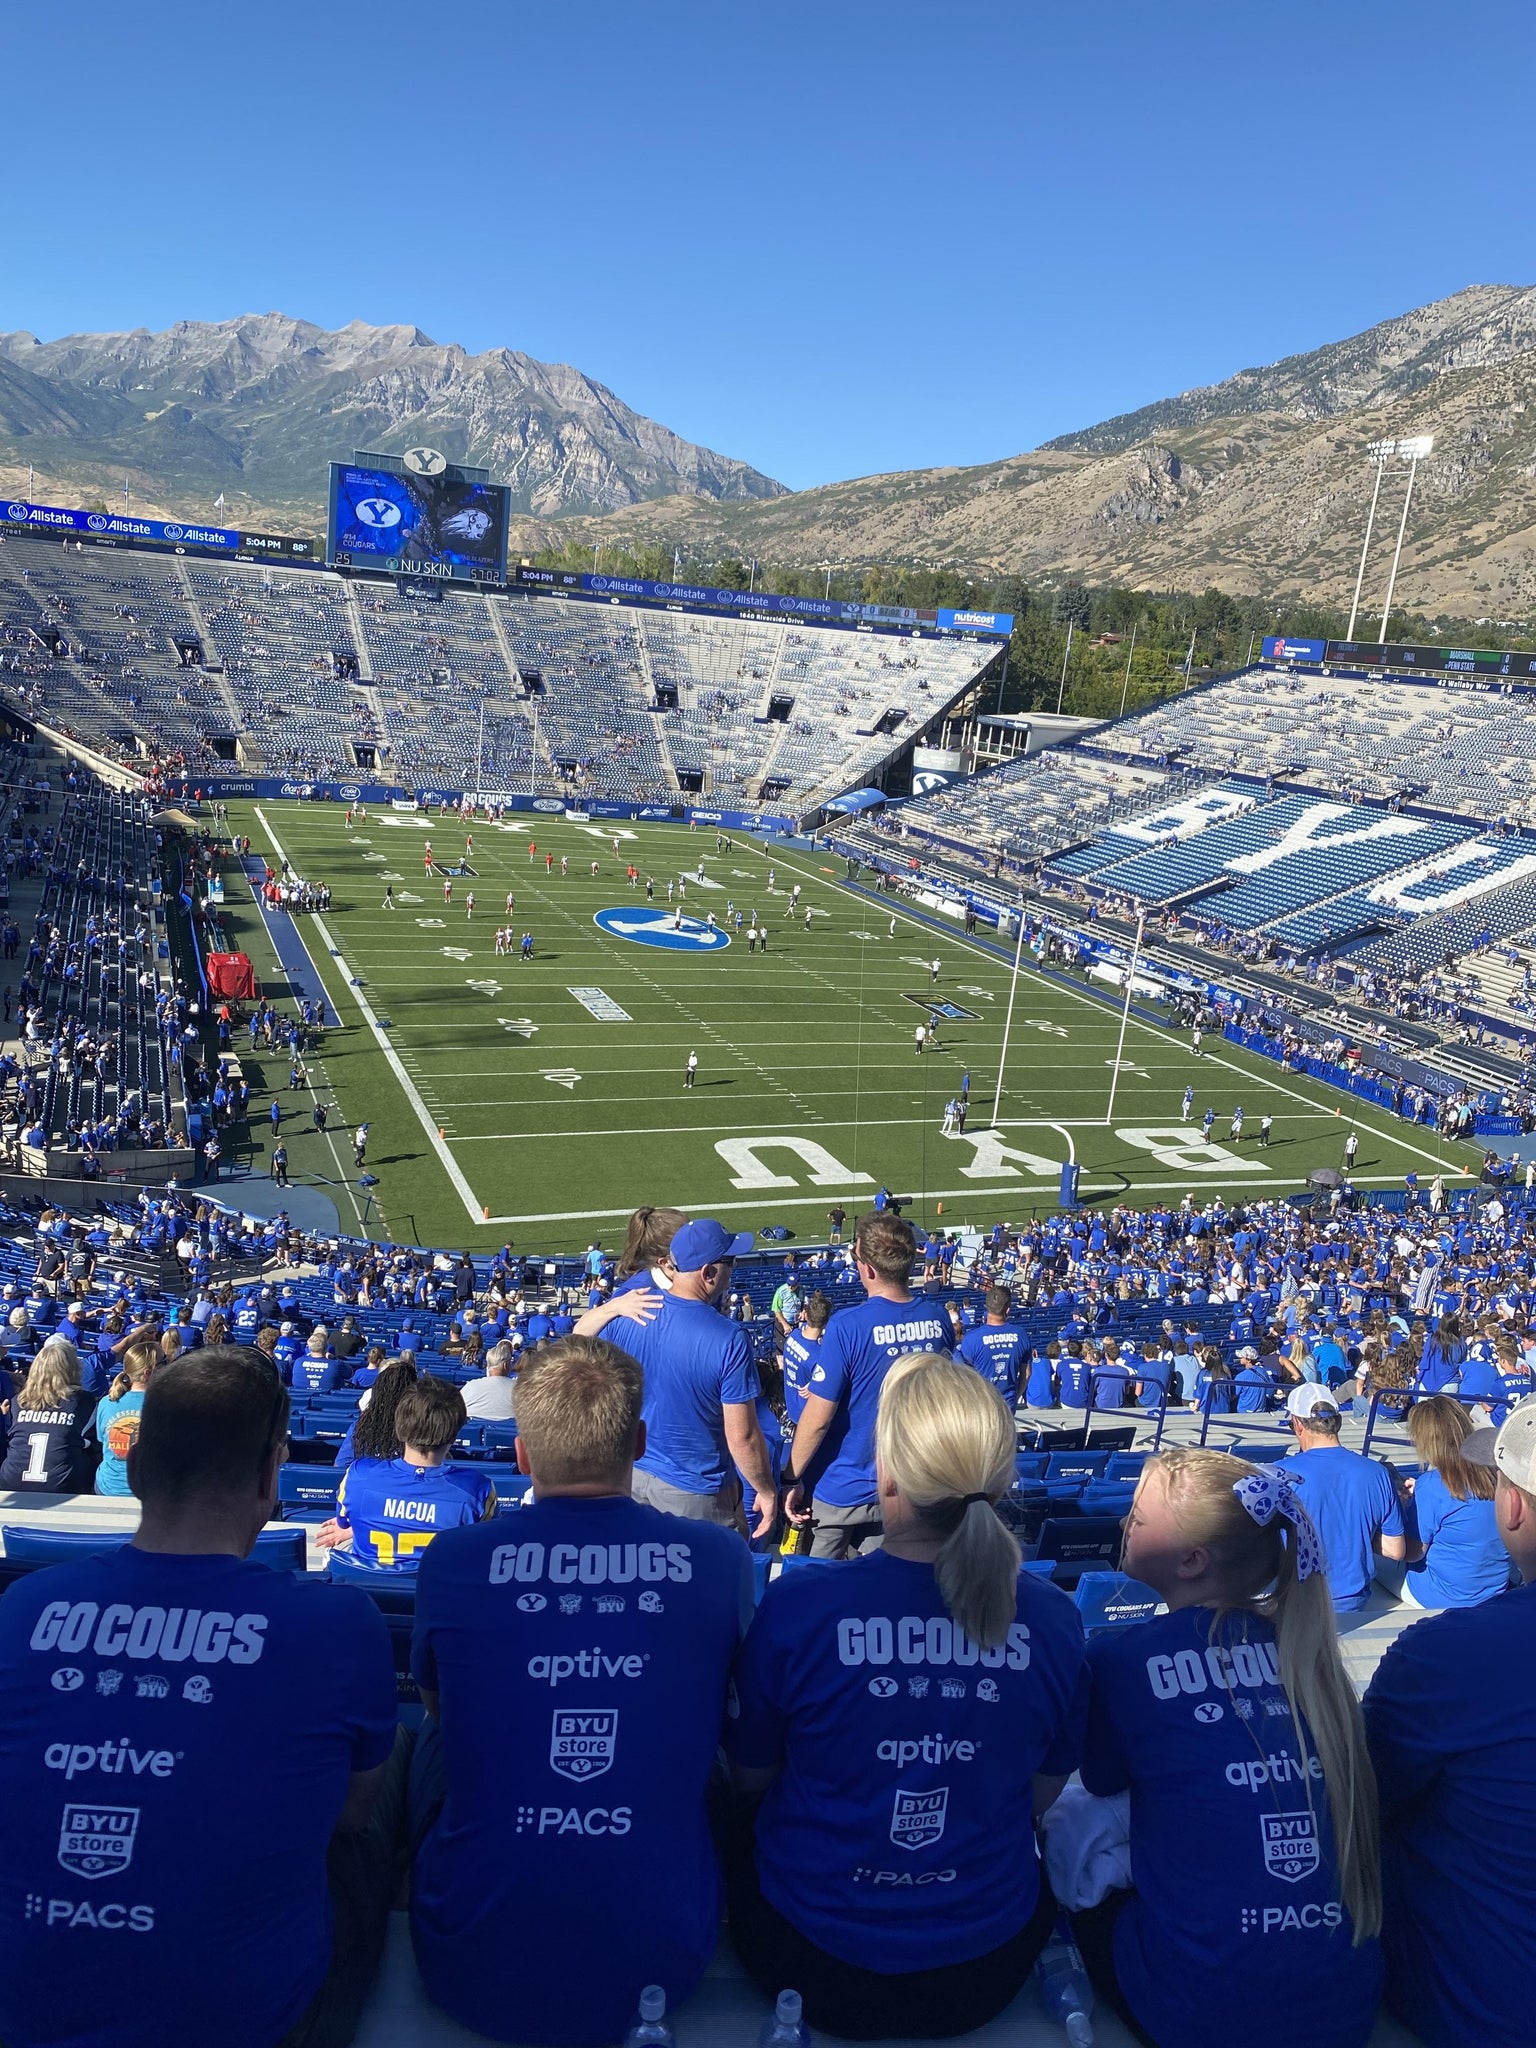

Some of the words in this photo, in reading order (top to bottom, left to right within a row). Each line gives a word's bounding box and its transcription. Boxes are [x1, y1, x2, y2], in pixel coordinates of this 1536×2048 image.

[412, 451, 438, 472] Y
[29, 509, 74, 525] Allstate
[364, 501, 394, 525] Y
[108, 519, 151, 535] Allstate
[183, 529, 226, 544] Allstate
[246, 537, 266, 548] 5:04
[267, 540, 281, 549] PM
[343, 540, 376, 550] COUGARS
[401, 559, 421, 573] NU
[423, 562, 453, 577] SKIN
[522, 571, 540, 581] 5:04
[541, 573, 554, 582] PM
[608, 580, 644, 593] Allstate
[670, 587, 706, 600] Allstate
[733, 594, 769, 607] Allstate
[796, 601, 831, 613] Allstate
[756, 614, 786, 623] Riverside
[787, 617, 804, 625] Drive
[954, 612, 996, 624] nutricost
[1460, 662, 1476, 672] STATE
[1448, 680, 1475, 691] Wallaby
[1476, 682, 1491, 691] Way
[221, 782, 255, 791] crumbl
[538, 801, 559, 811] Ford
[691, 811, 722, 821] GEICO
[1047, 925, 1080, 942] FOOTBALL
[1300, 1025, 1326, 1043] PACS
[1373, 1054, 1402, 1074] PACS
[1424, 1073, 1456, 1094] PACS
[239, 1310, 258, 1327] 23
[873, 1324, 896, 1346] GO
[896, 1320, 943, 1344] COUGS
[983, 1335, 994, 1345] GO
[994, 1333, 1018, 1343] COUGS
[1505, 1379, 1522, 1387] BYU
[18, 1410, 76, 1426] COUGARS
[22, 1432, 50, 1483] 1
[383, 1498, 436, 1524] NACUA
[489, 1542, 545, 1584] GO
[548, 1543, 693, 1584] COUGS
[597, 1602, 626, 1613] BYU
[1117, 1604, 1140, 1612] COUGARS
[30, 1601, 99, 1653] GO
[93, 1603, 269, 1664] COUGS
[837, 1617, 893, 1666] GO
[528, 1647, 643, 1687] aptive
[1146, 1649, 1208, 1700] GO
[1204, 1642, 1283, 1690] COU
[136, 1682, 169, 1698] BYU
[941, 1686, 966, 1698] BYU
[561, 1718, 610, 1734] BYU
[558, 1737, 608, 1754] store
[876, 1733, 975, 1768] aptive
[44, 1737, 175, 1780] aptive
[1225, 1749, 1324, 1793] aptive
[902, 1795, 941, 1813] BYU
[71, 1813, 129, 1833] BYU
[538, 1806, 633, 1835] PACS
[898, 1814, 939, 1829] store
[1269, 1819, 1311, 1838] BYU
[67, 1835, 125, 1854] store
[1271, 1841, 1313, 1858] store
[47, 1899, 155, 1932] PACS
[1263, 1901, 1343, 1934] PACS
